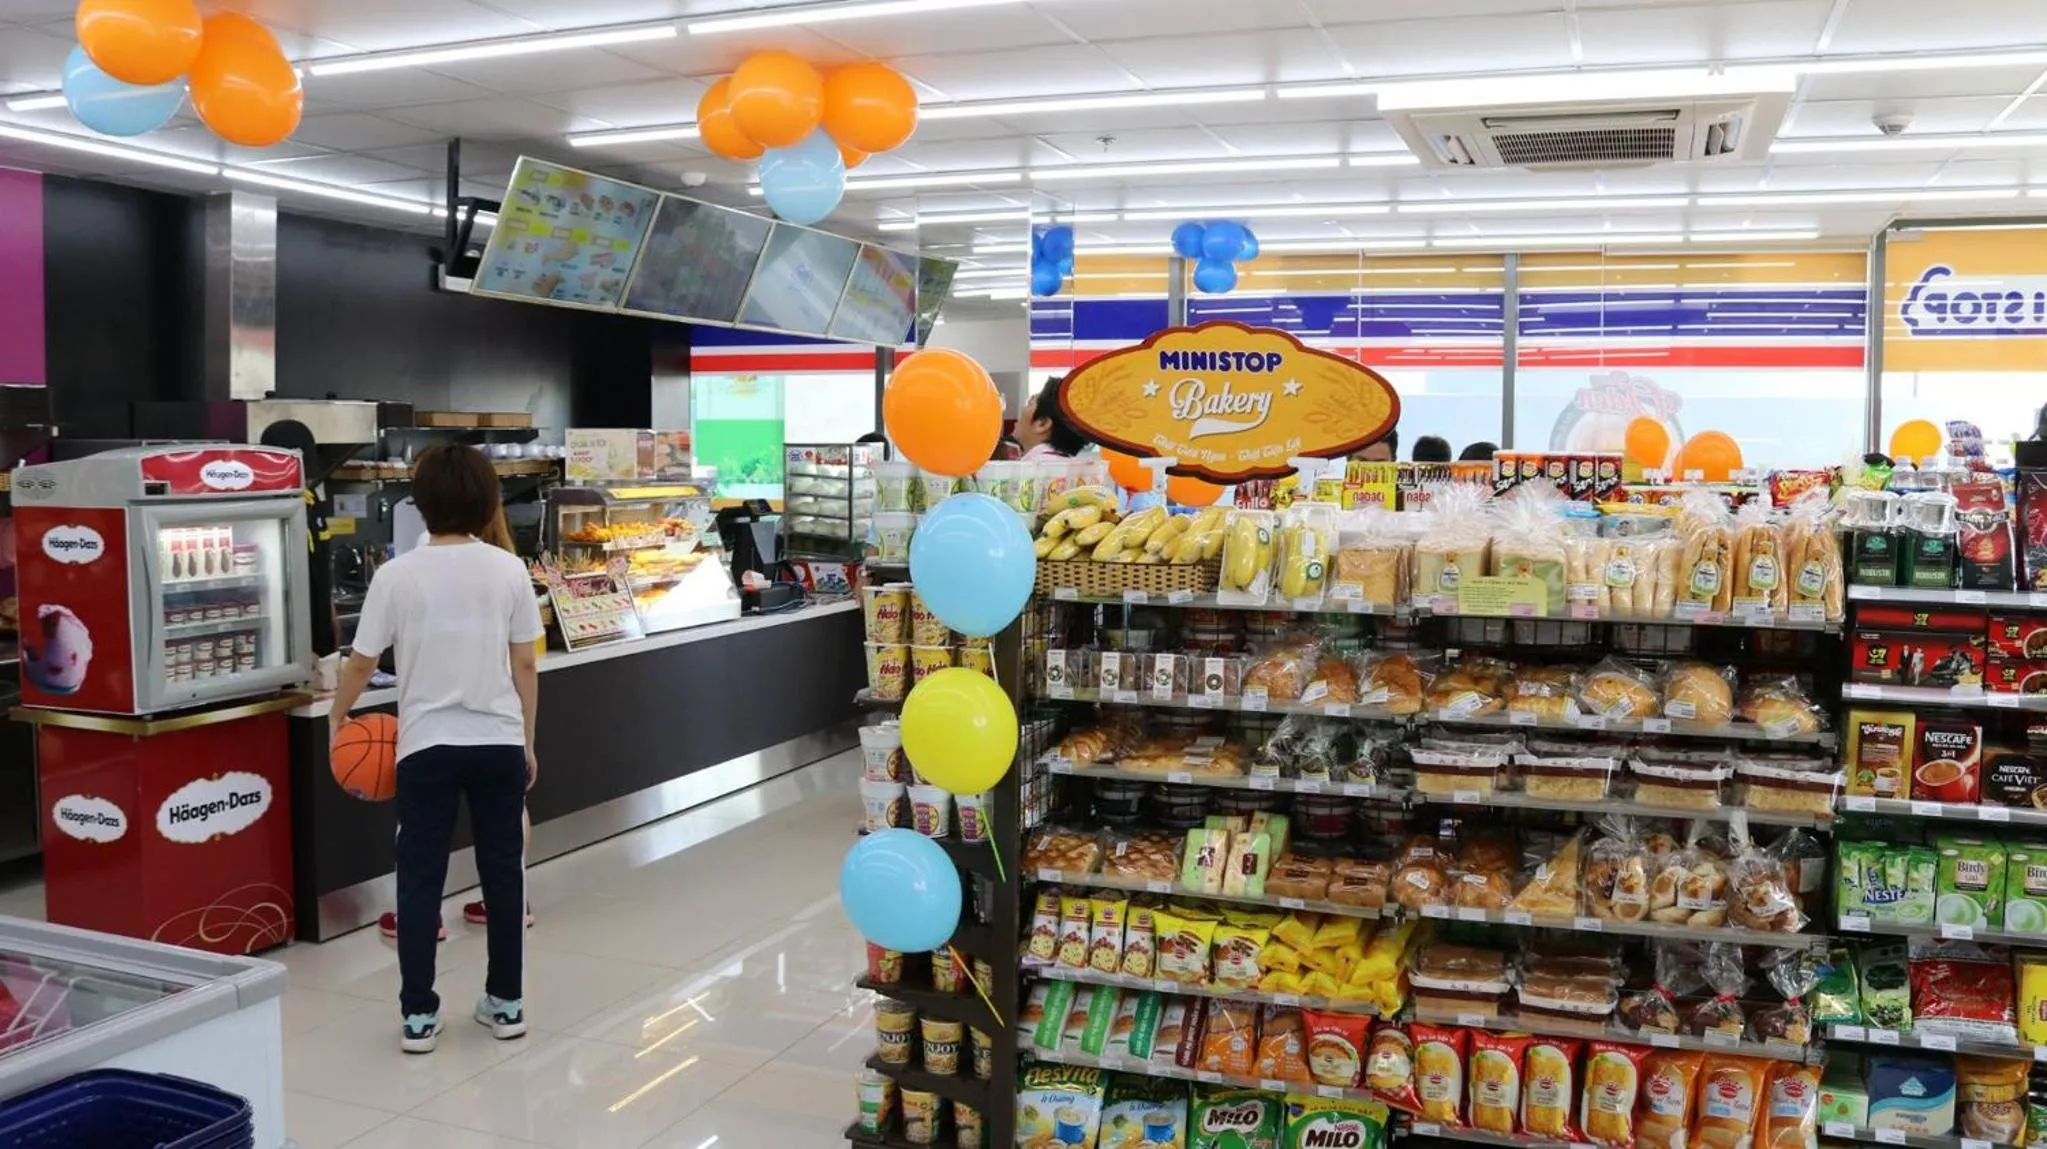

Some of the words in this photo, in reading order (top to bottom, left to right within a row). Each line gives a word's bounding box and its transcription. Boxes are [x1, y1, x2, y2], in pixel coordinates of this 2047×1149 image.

[1158, 350, 1283, 373] MINISTOP
[1168, 377, 1273, 439] Bakery
[60, 806, 120, 828] Häagen-Dazs
[169, 790, 262, 825] Häagen-Dazs
[1207, 1109, 1259, 1126] MILO
[1305, 1130, 1360, 1148] MILO
